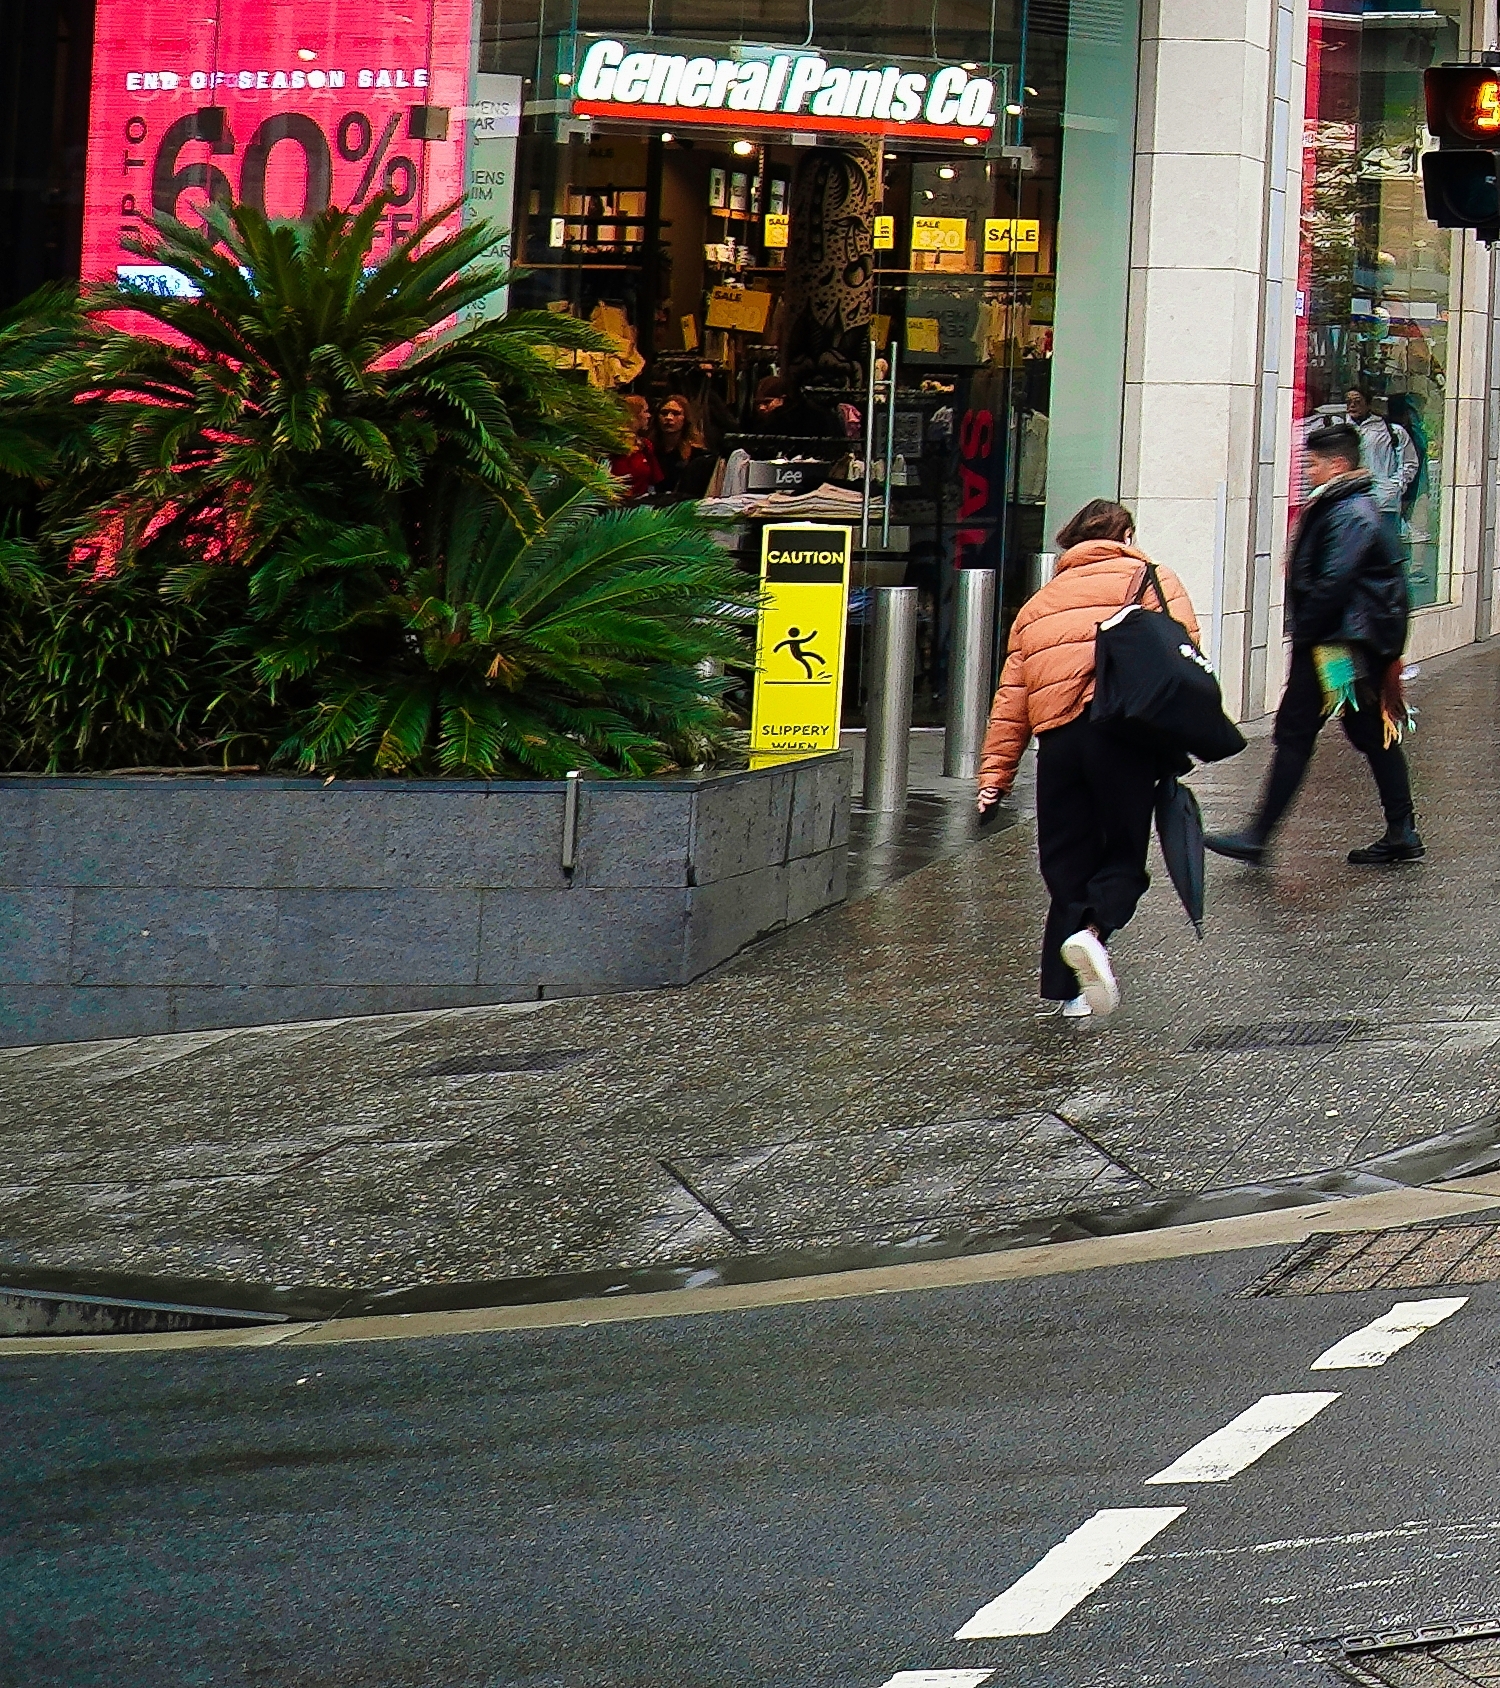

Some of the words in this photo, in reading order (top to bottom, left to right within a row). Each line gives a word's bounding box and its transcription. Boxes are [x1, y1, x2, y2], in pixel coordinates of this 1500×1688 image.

[126, 73, 180, 92] END
[237, 70, 347, 91] SEASON
[357, 68, 431, 89] SALE
[577, 40, 791, 113] General
[783, 56, 927, 122] Pants
[925, 67, 997, 127] Co.
[120, 115, 148, 176] TO
[988, 228, 1037, 243] SALE
[775, 467, 803, 485] Lee
[767, 550, 844, 565] CAUTION
[761, 724, 830, 736] SLIPPERY
